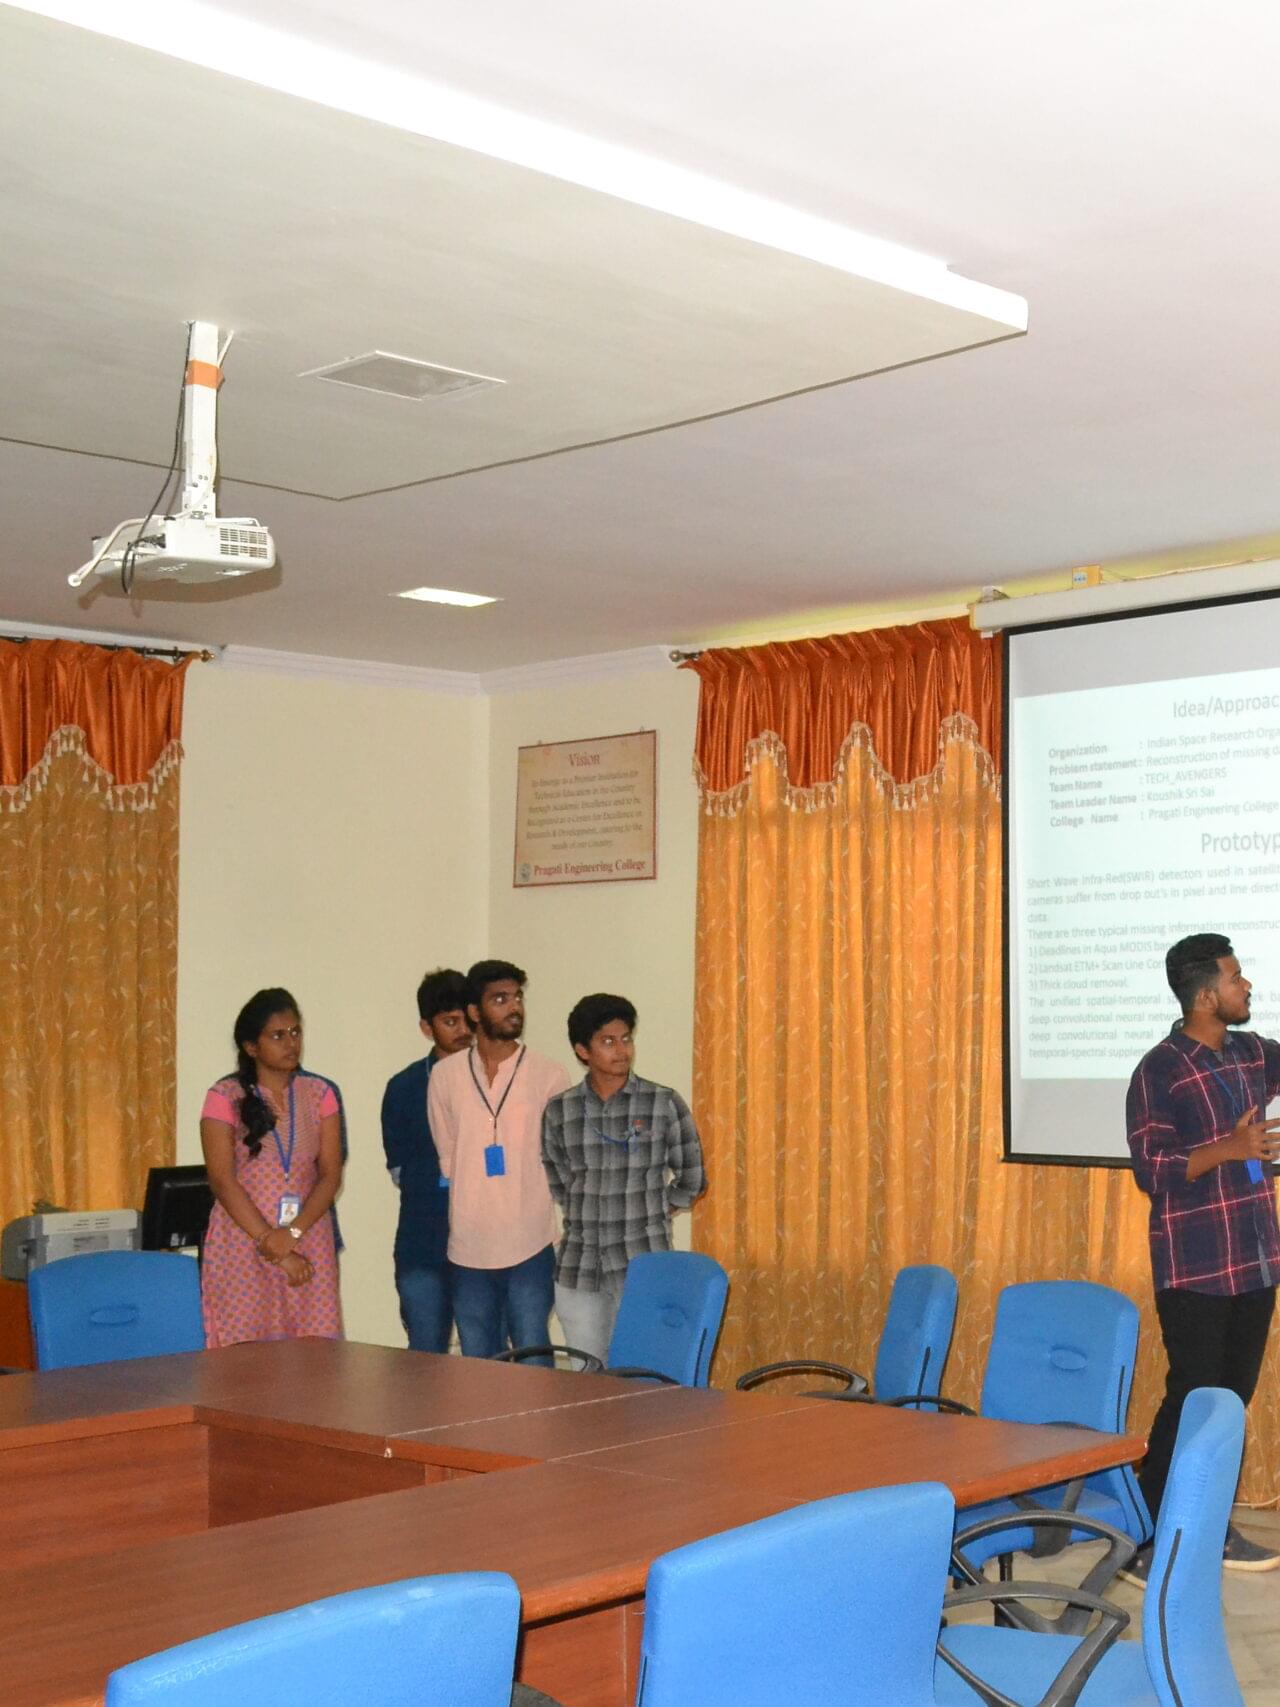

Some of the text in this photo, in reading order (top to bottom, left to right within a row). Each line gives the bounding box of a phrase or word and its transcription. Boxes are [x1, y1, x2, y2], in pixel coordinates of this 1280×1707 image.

[1049, 743, 1108, 760] Organization
[1147, 737, 1176, 749] Indian
[1179, 735, 1207, 748] Space
[1210, 729, 1255, 744] Research
[568, 752, 601, 768] Vision
[1049, 762, 1088, 776] Problem
[1146, 750, 1218, 768] Reconstruction
[1219, 748, 1230, 760] of
[1233, 746, 1270, 761] missing
[1145, 767, 1228, 785] TECH_AVENGERS
[1049, 779, 1103, 793] Team Name
[1146, 786, 1216, 802] Koushik Sri Sai
[1050, 794, 1137, 810] Team Leader Name
[1148, 799, 1280, 821] Pragati Engineering College
[1050, 813, 1119, 829] College Name
[565, 861, 614, 875] Engineering
[615, 858, 646, 871] College
[1027, 877, 1051, 889] Short
[1053, 876, 1078, 888] Wave
[1158, 867, 1202, 882] detectors
[1207, 865, 1231, 878] used
[1234, 864, 1244, 877] in
[1027, 895, 1064, 907] cameras
[1066, 891, 1091, 904] suffer
[1094, 889, 1116, 902] from
[1119, 889, 1142, 902] drop
[1170, 886, 1180, 899] in
[1182, 884, 1205, 898] pixel
[1208, 884, 1227, 896] and
[1230, 883, 1248, 895] line
[1028, 927, 1055, 940] There
[1056, 929, 1069, 939] are
[1071, 926, 1096, 939] three
[1098, 924, 1128, 939] typical
[1130, 923, 1167, 936] missing
[1168, 919, 1225, 934] information
[1039, 943, 1081, 956] Deadlines
[1083, 942, 1092, 954] in
[1094, 943, 1117, 956] Aqua
[1120, 941, 1152, 953] MODIS
[1039, 961, 1072, 974] Landsat
[1074, 960, 1100, 973] ETM+
[1101, 959, 1123, 972] Scan
[1125, 958, 1144, 971] Line
[1039, 979, 1061, 991] Thick
[1063, 978, 1088, 990] cloud
[1029, 996, 1045, 1008] The
[1050, 995, 1081, 1007] unified
[1086, 993, 1161, 1008] spatial-temporal
[1028, 1014, 1050, 1027] deep
[1053, 1012, 1113, 1025] convolutional
[1115, 1011, 1145, 1024] neural
[1028, 1031, 1050, 1042] deep
[1056, 1028, 1117, 1041] convolutional
[1125, 1027, 1154, 1040] neural
